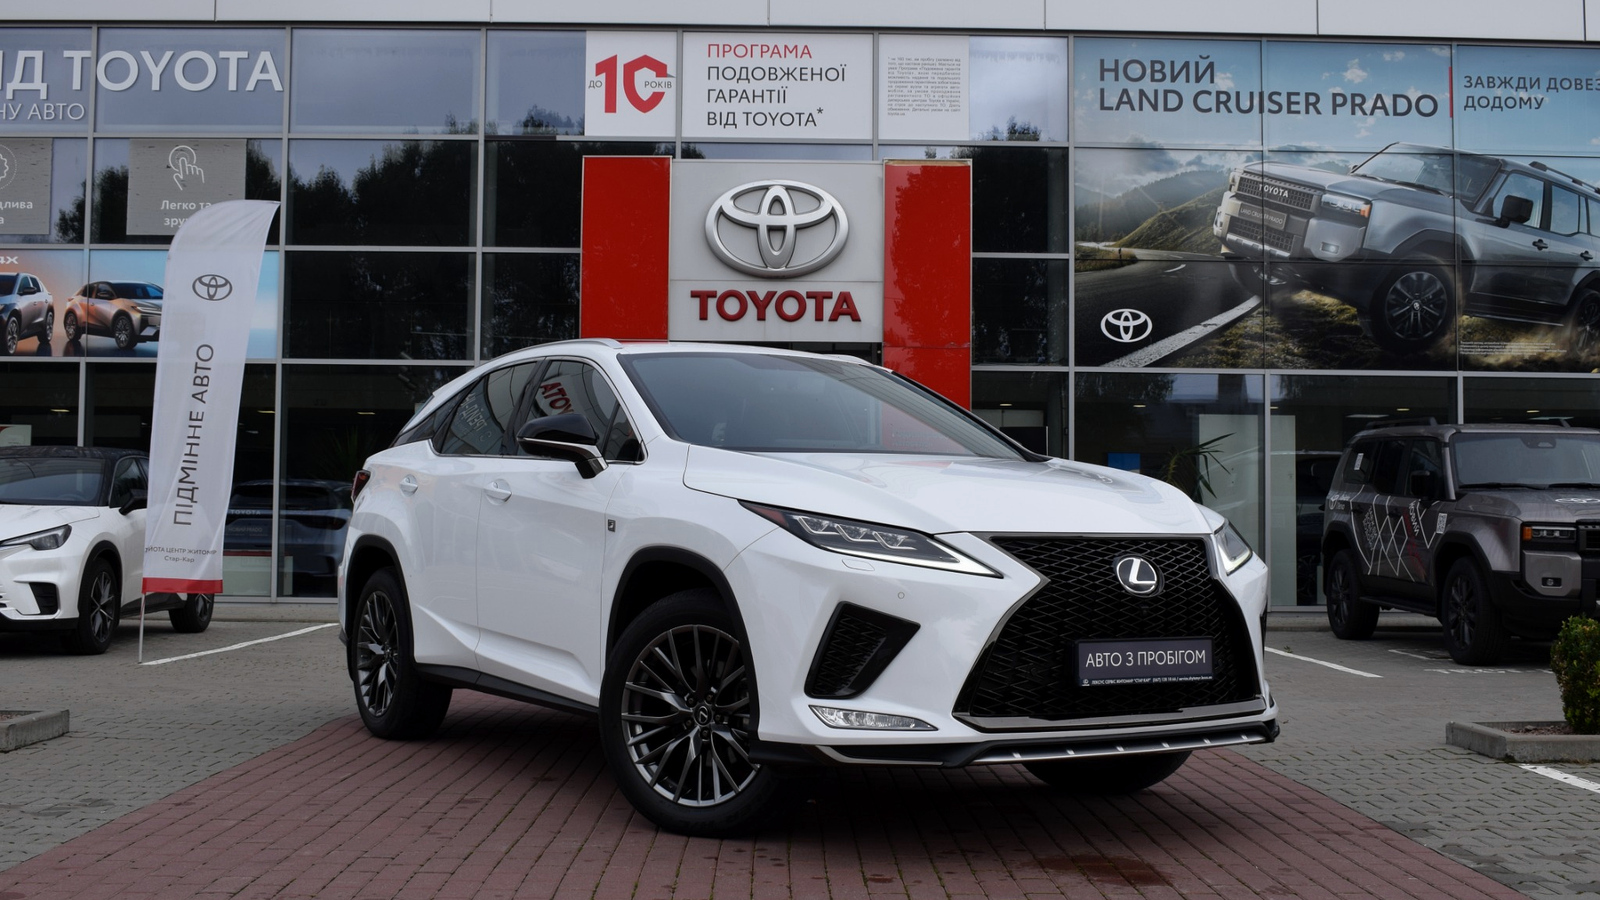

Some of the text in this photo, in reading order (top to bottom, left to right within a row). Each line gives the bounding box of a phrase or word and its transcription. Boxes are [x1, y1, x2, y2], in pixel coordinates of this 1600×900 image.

[707, 43, 812, 60] ПРОГРАМА
[63, 50, 284, 92] TOYOTA
[707, 64, 847, 83] ПОДОВЖЕНОЇ
[1099, 54, 1215, 84] НОВИЙ
[644, 81, 672, 89] РОКІВ
[1463, 75, 1541, 92] ЗАВЖДИ
[707, 86, 788, 104] ГАРАНТІЇ
[1099, 88, 1439, 118] LAND CRUISER PRADO
[1463, 95, 1544, 112] ДОДОМУ
[27, 103, 85, 120] АВТО
[707, 111, 737, 129] ВІД
[160, 200, 197, 210] Легко
[163, 217, 188, 228] зру
[690, 289, 862, 322] TOYOTA
[173, 344, 214, 526] ПІДМІННЕ АВТО
[1085, 650, 1206, 668] АВТО З ПРОБІГОМ
